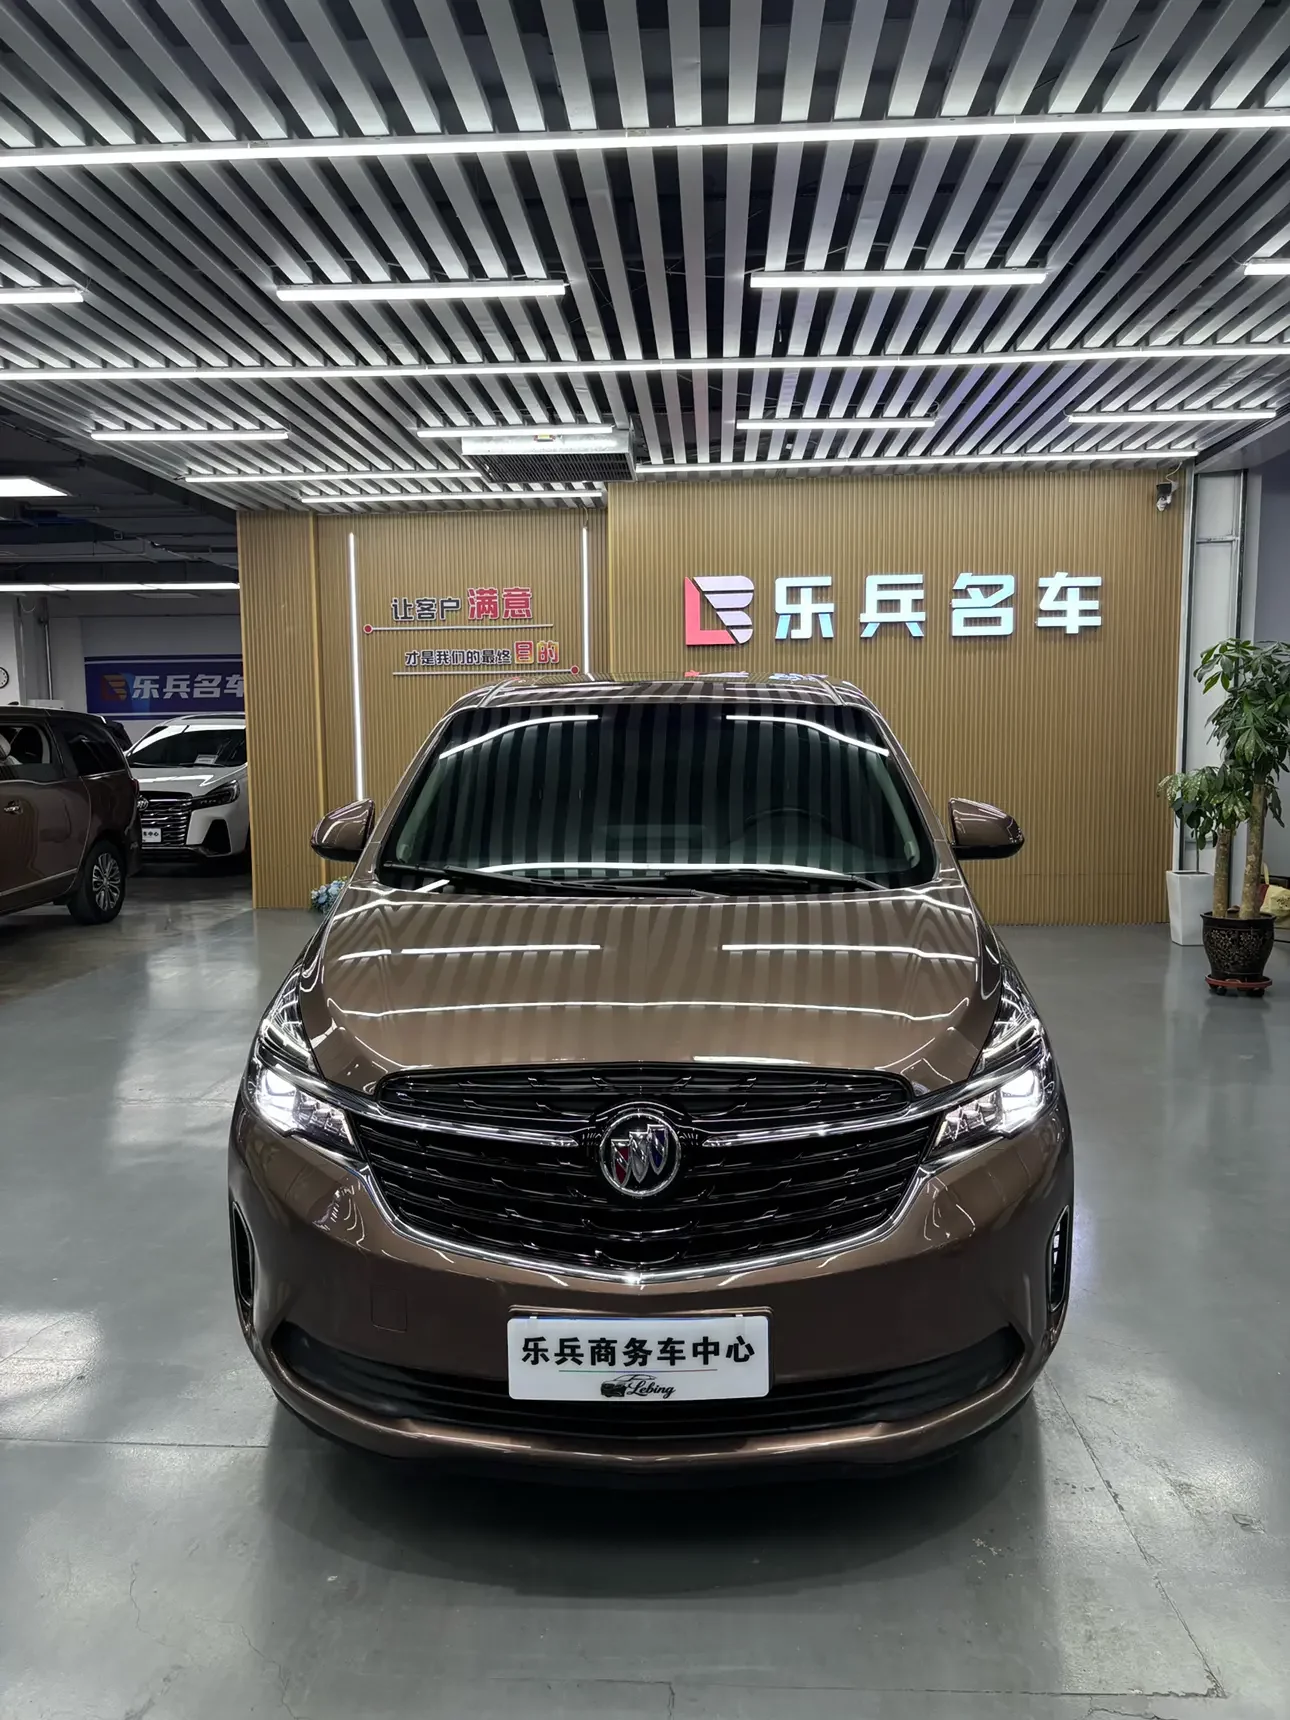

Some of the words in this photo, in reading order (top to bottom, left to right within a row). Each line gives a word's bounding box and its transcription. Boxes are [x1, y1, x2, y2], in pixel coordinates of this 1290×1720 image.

[391, 587, 533, 621] 让客户满意
[774, 572, 1102, 639] 乐兵名车
[404, 640, 560, 665] 才是我们的最终目的
[132, 674, 244, 699] 乐兵名车
[521, 1336, 755, 1367] 乐兵商务车中心
[626, 1380, 676, 1399] Lebing
